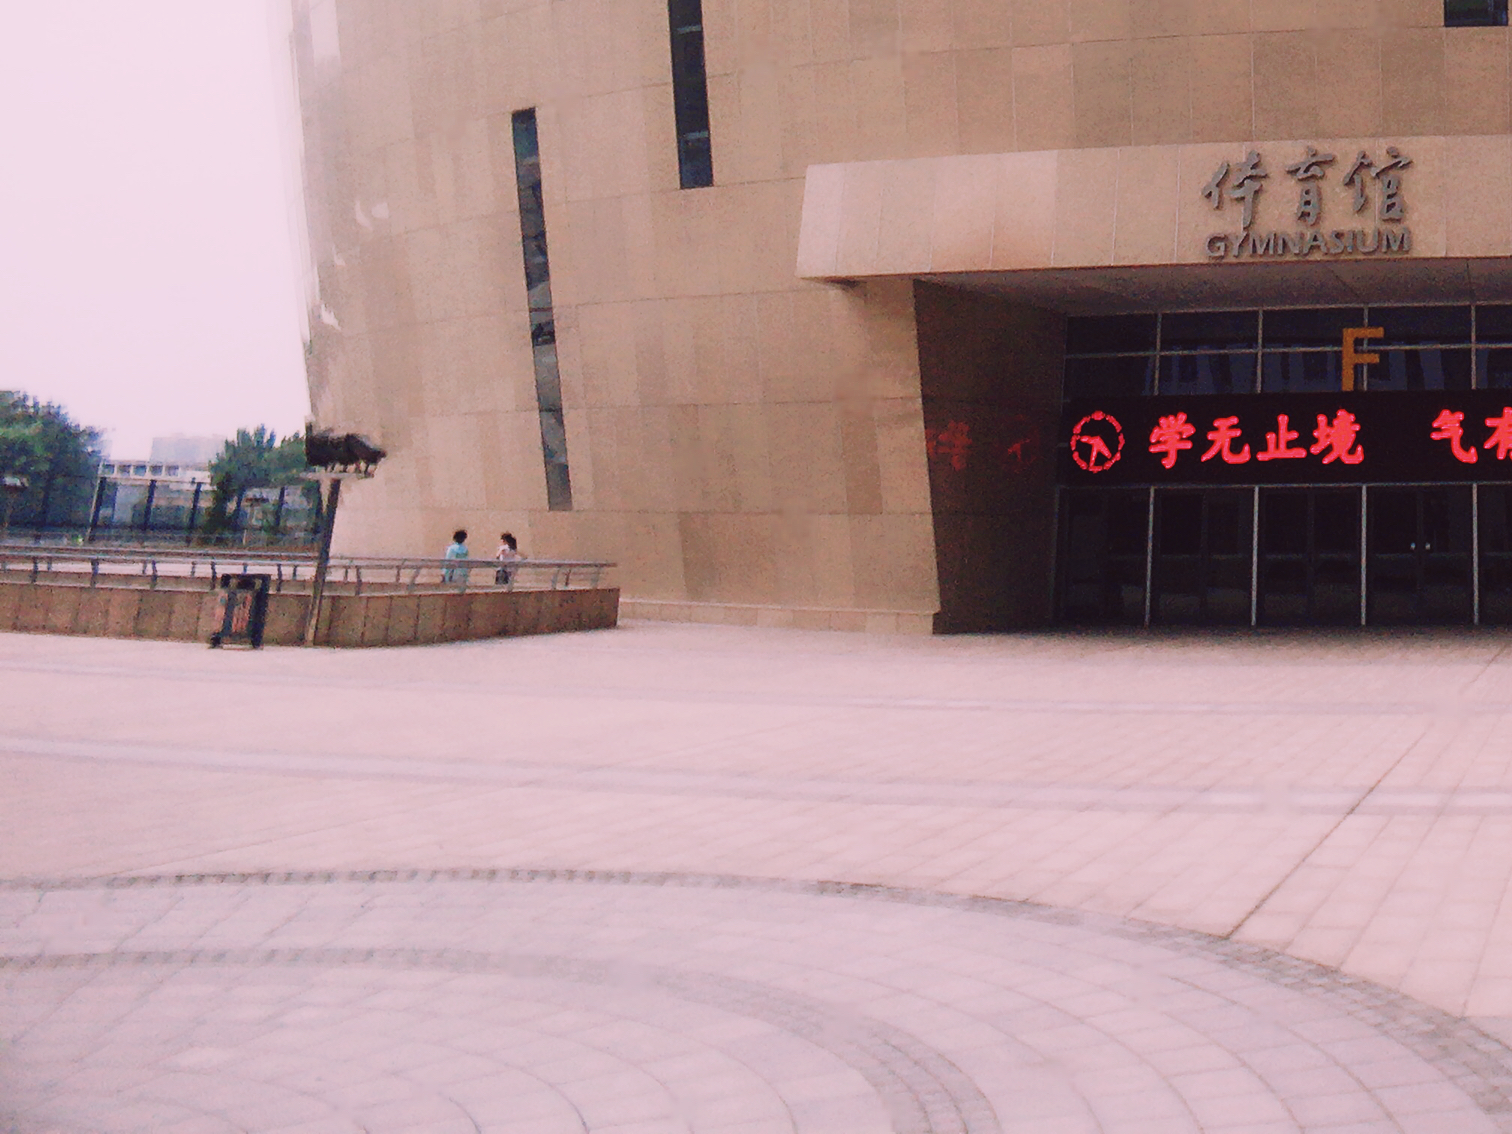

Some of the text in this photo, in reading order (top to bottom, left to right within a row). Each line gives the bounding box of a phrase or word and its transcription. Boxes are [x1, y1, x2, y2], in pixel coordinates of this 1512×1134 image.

[1201, 146, 1413, 230] 体育馆
[1205, 227, 1412, 259] GYMNASIUM
[1341, 326, 1385, 392] F
[1148, 408, 1365, 470] 学无止境
